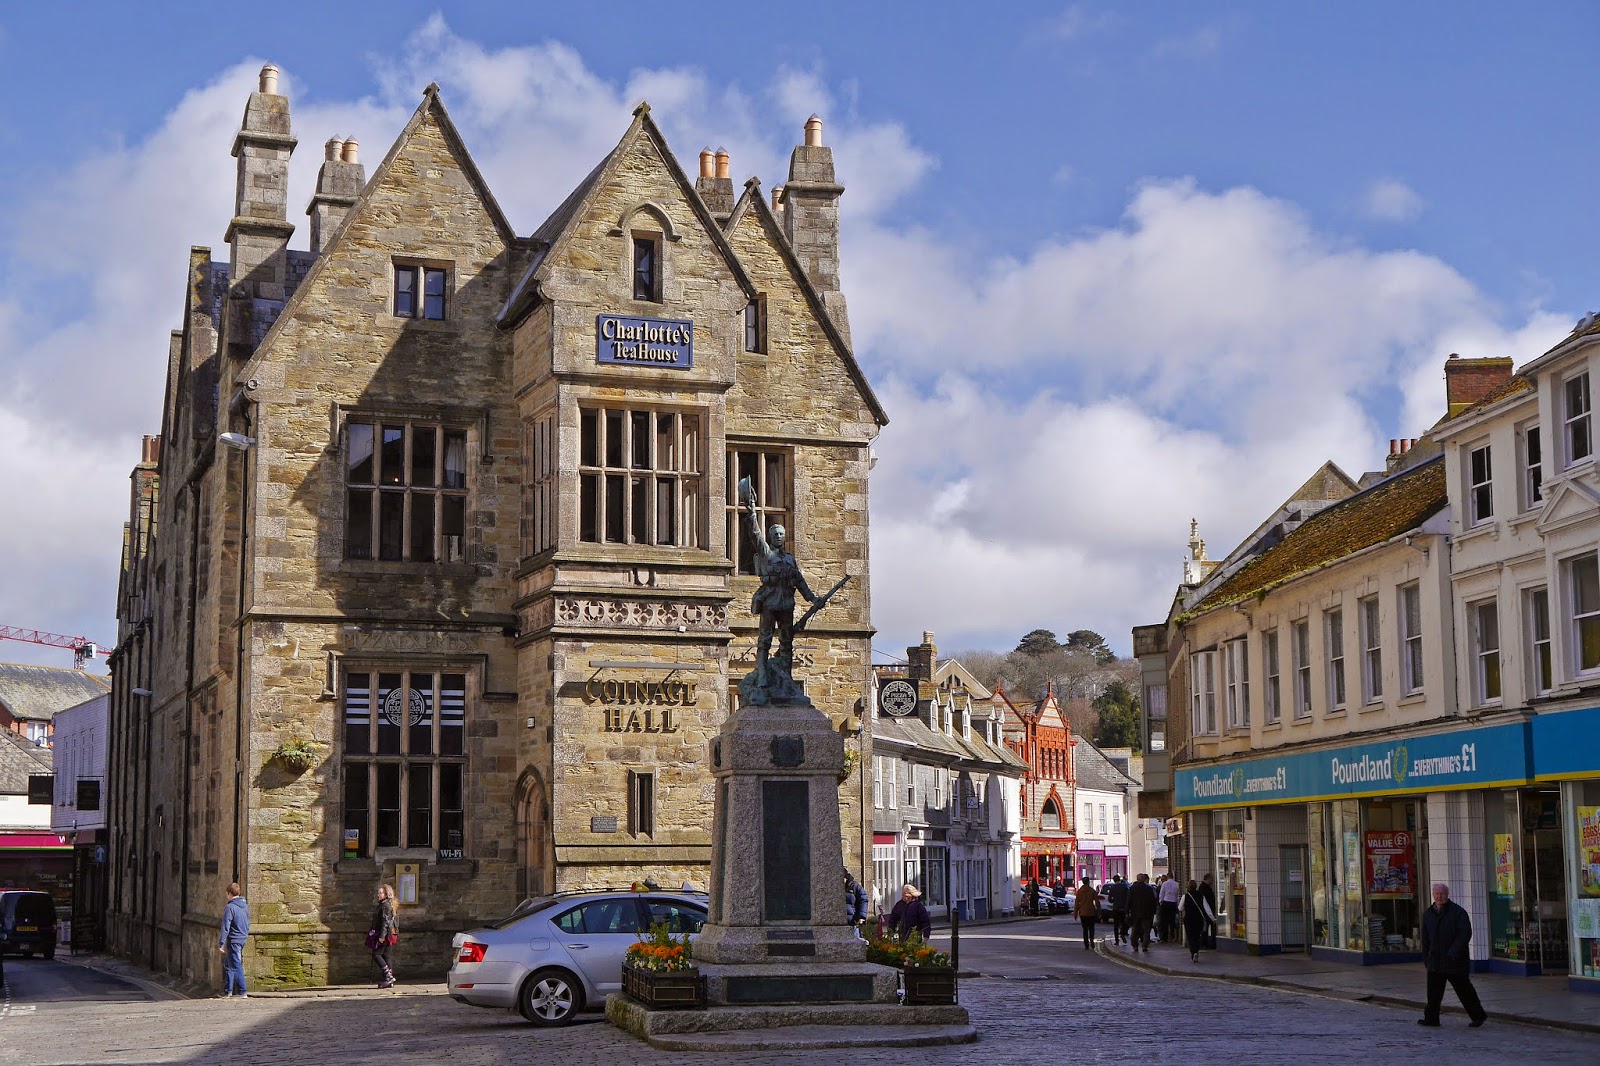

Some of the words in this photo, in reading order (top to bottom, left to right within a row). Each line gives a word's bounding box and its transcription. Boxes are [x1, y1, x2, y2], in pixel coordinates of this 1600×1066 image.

[602, 319, 690, 345] Charlotte's
[585, 678, 700, 704] COINAGE
[605, 707, 679, 732] HALL
[1332, 752, 1392, 784] Poundland
[1462, 743, 1476, 772] £1
[1193, 772, 1233, 797] Poundland
[1277, 767, 1286, 789] £1
[440, 849, 462, 858] Wi-Fi
[1368, 839, 1393, 848] VALUE
[1397, 836, 1407, 846] £1
